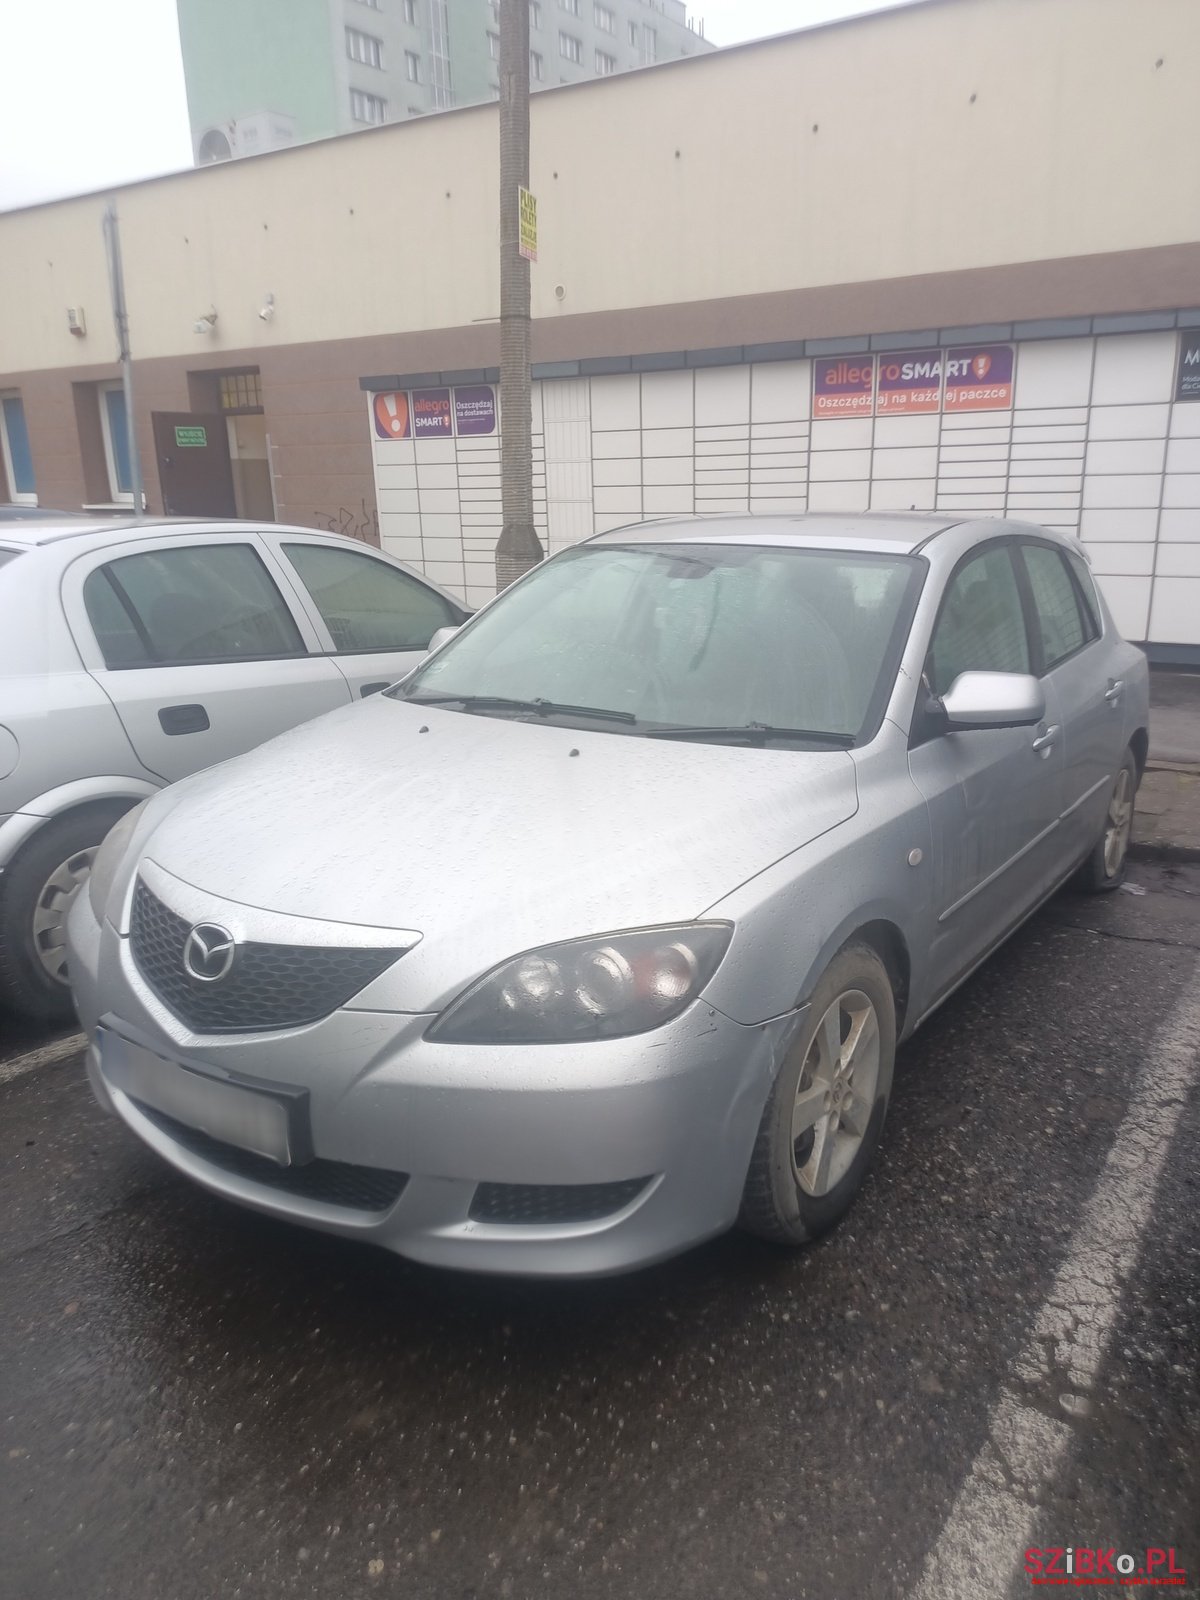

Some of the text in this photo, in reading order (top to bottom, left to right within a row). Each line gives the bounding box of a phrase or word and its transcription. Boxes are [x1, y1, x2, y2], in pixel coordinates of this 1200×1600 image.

[891, 394, 907, 404] na
[959, 388, 1007, 403] paczce
[414, 399, 450, 415] allegro
[456, 400, 493, 410] Oszczędzaj
